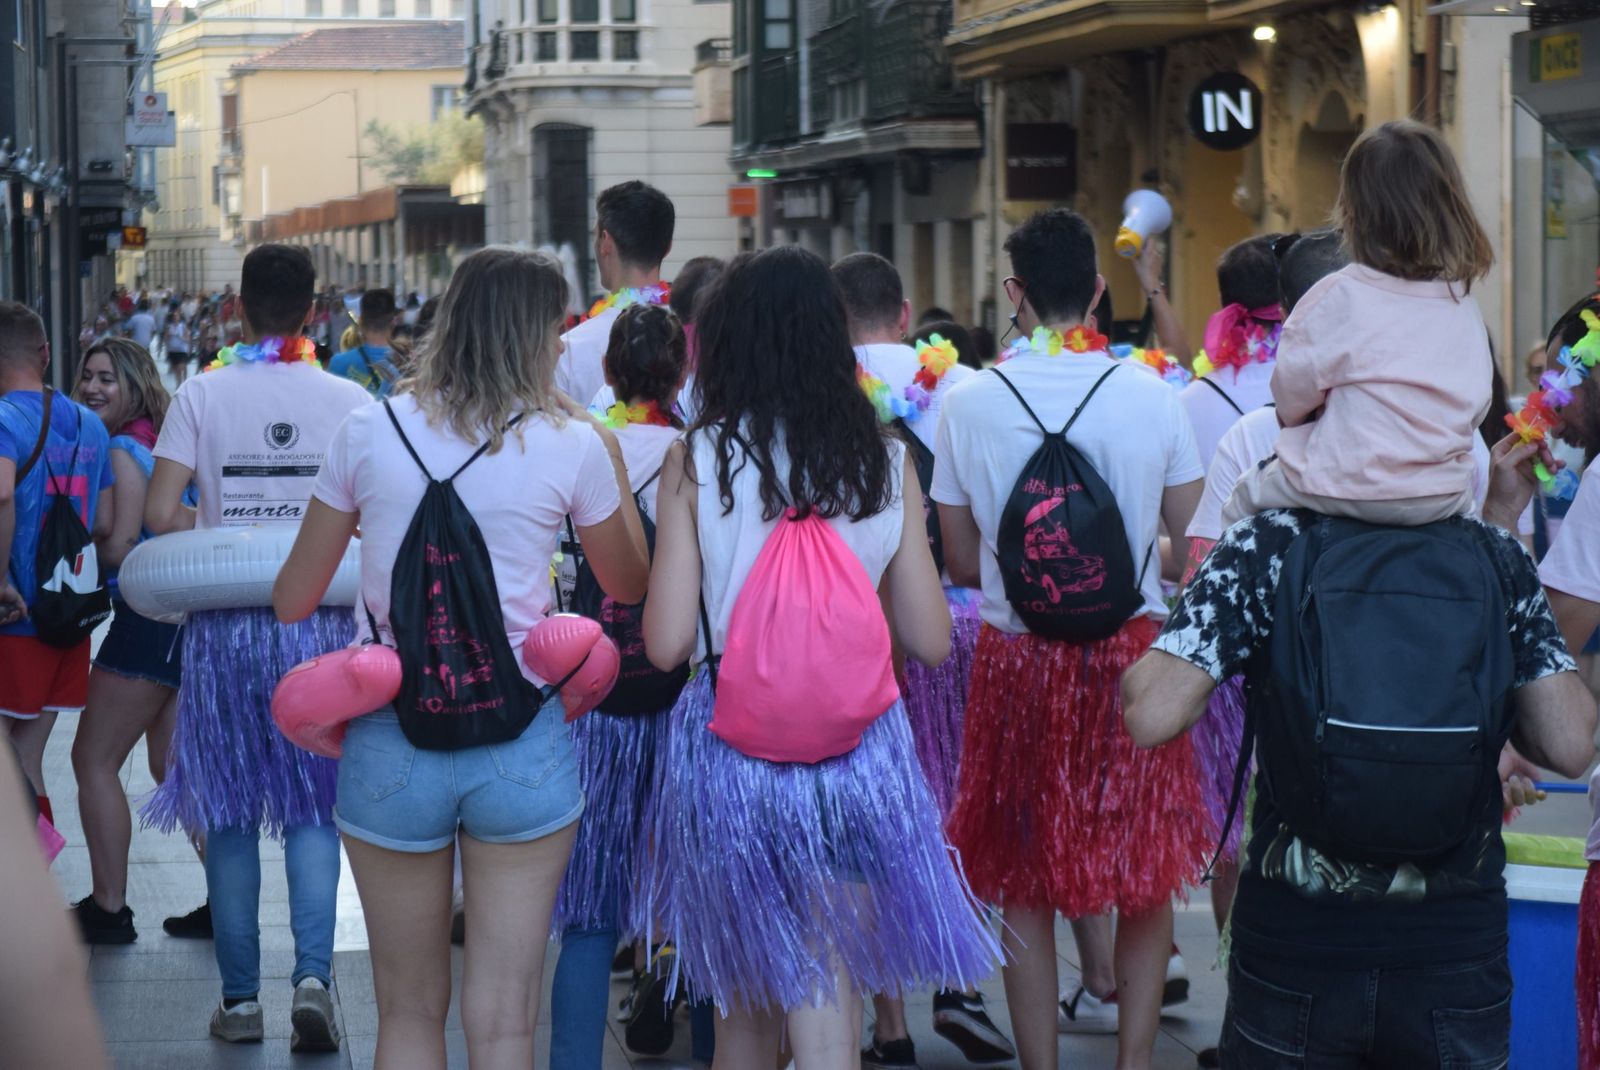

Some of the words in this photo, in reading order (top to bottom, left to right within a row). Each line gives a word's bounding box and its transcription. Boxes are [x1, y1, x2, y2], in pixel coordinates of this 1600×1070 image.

[1544, 38, 1579, 73] ONCE
[1202, 88, 1254, 132] IN
[274, 453, 315, 461] ABOGADOS
[222, 504, 303, 518] marta
